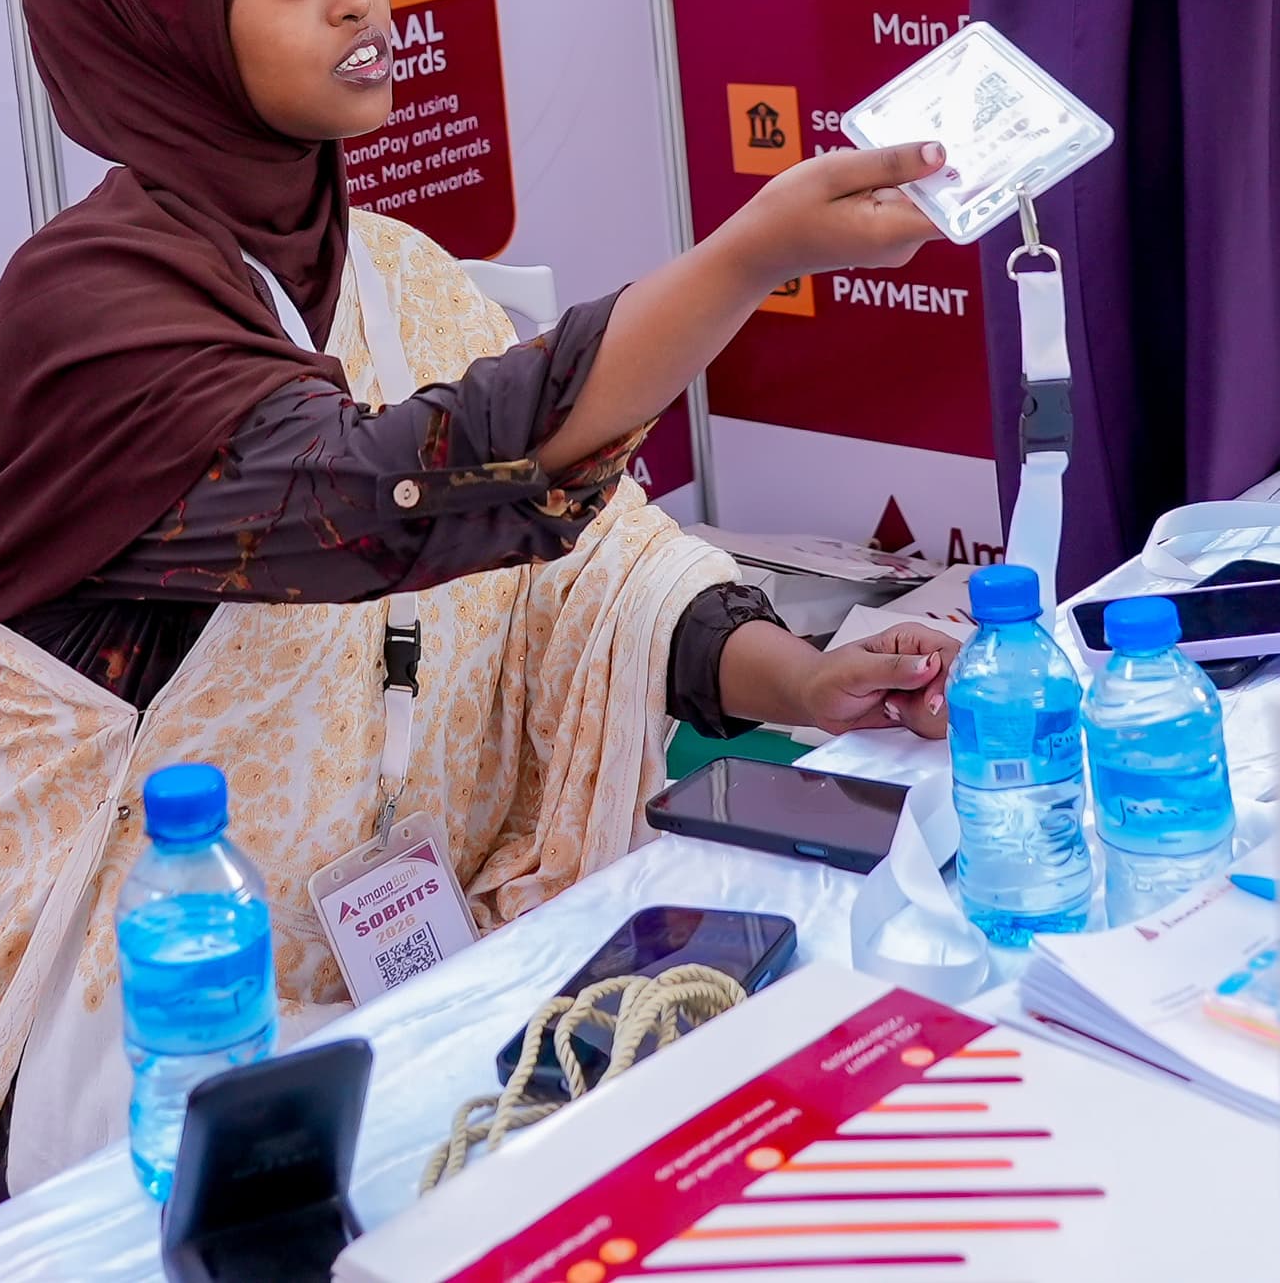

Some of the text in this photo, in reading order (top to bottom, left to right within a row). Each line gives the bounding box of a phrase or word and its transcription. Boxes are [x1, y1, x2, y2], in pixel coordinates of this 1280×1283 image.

[874, 13, 948, 47] Main
[833, 276, 968, 315] PAYMENT
[355, 879, 438, 938] SOBFITS
[376, 914, 416, 945] 2026
